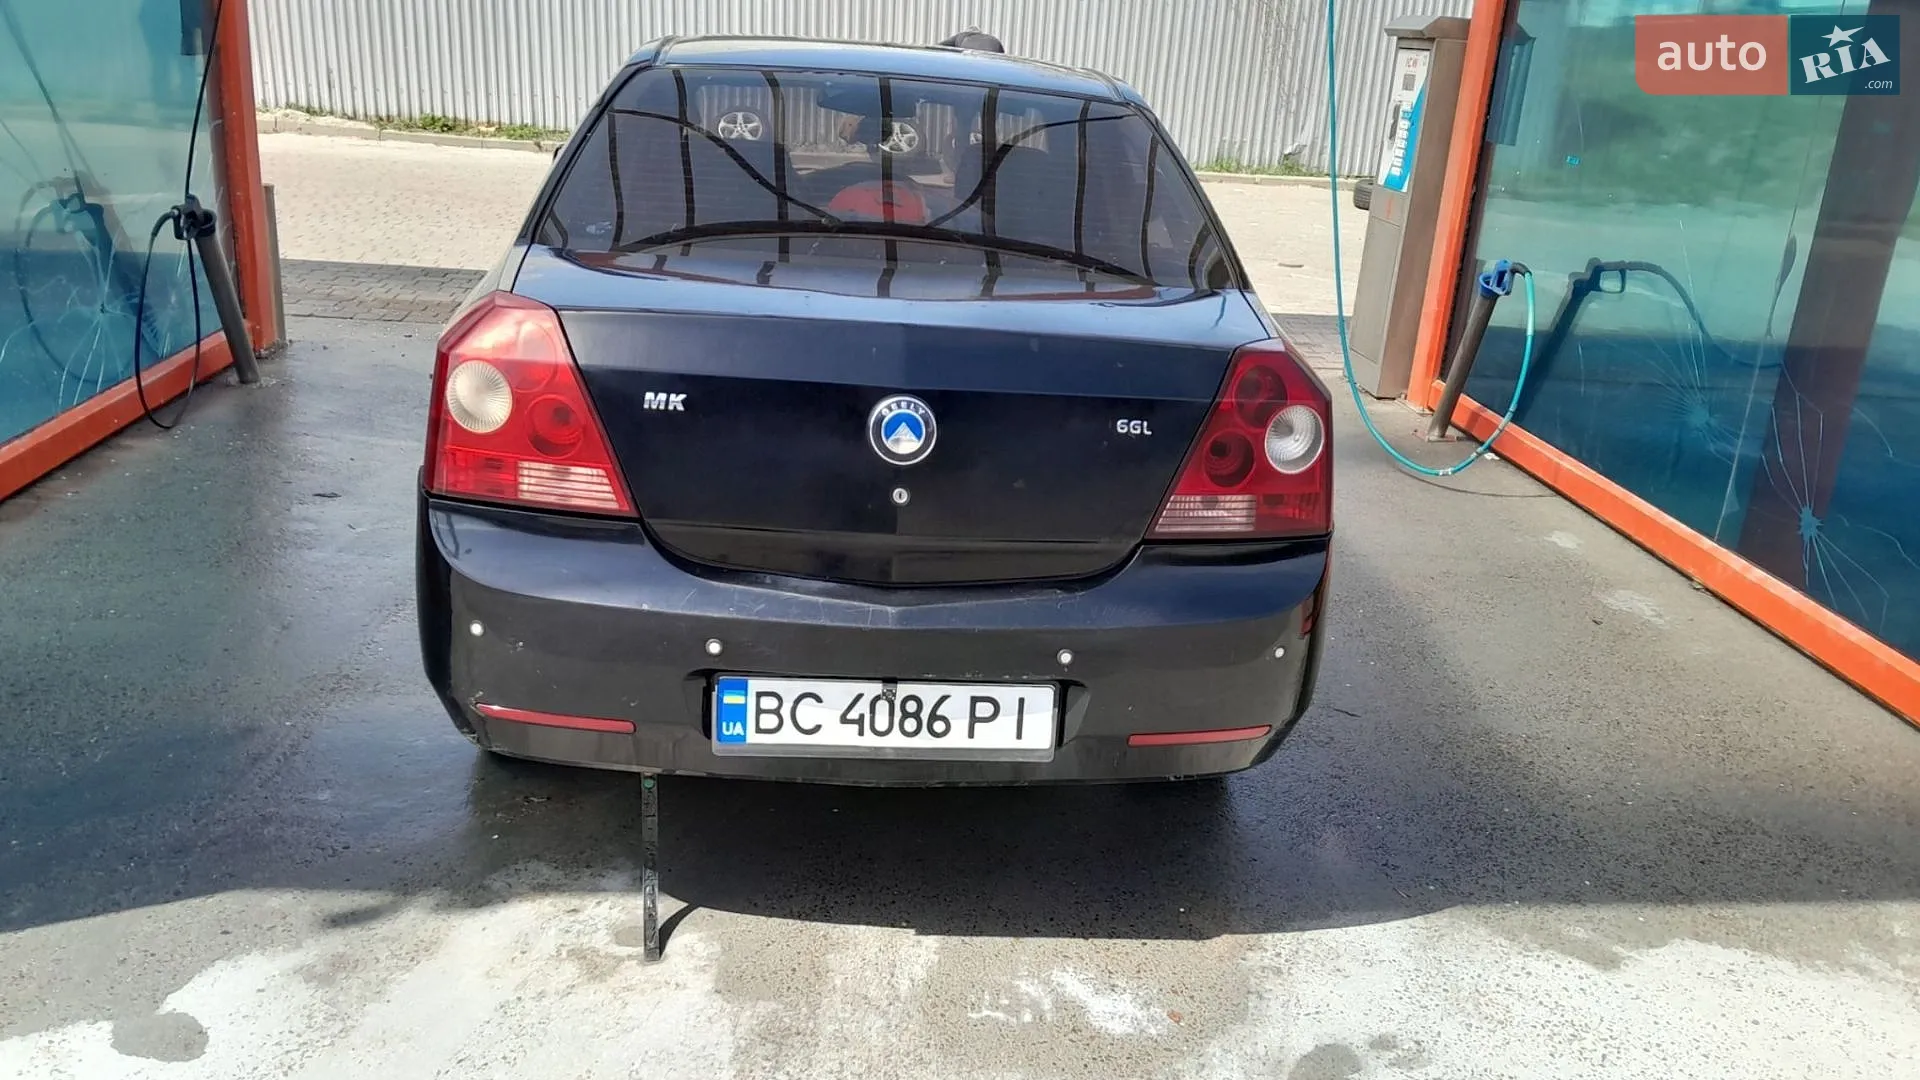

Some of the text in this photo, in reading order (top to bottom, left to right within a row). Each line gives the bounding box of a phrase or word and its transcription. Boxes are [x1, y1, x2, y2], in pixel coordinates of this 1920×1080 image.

[643, 391, 687, 411] MK
[754, 690, 1024, 740] BC 4086 PI
[721, 722, 744, 736] UA
